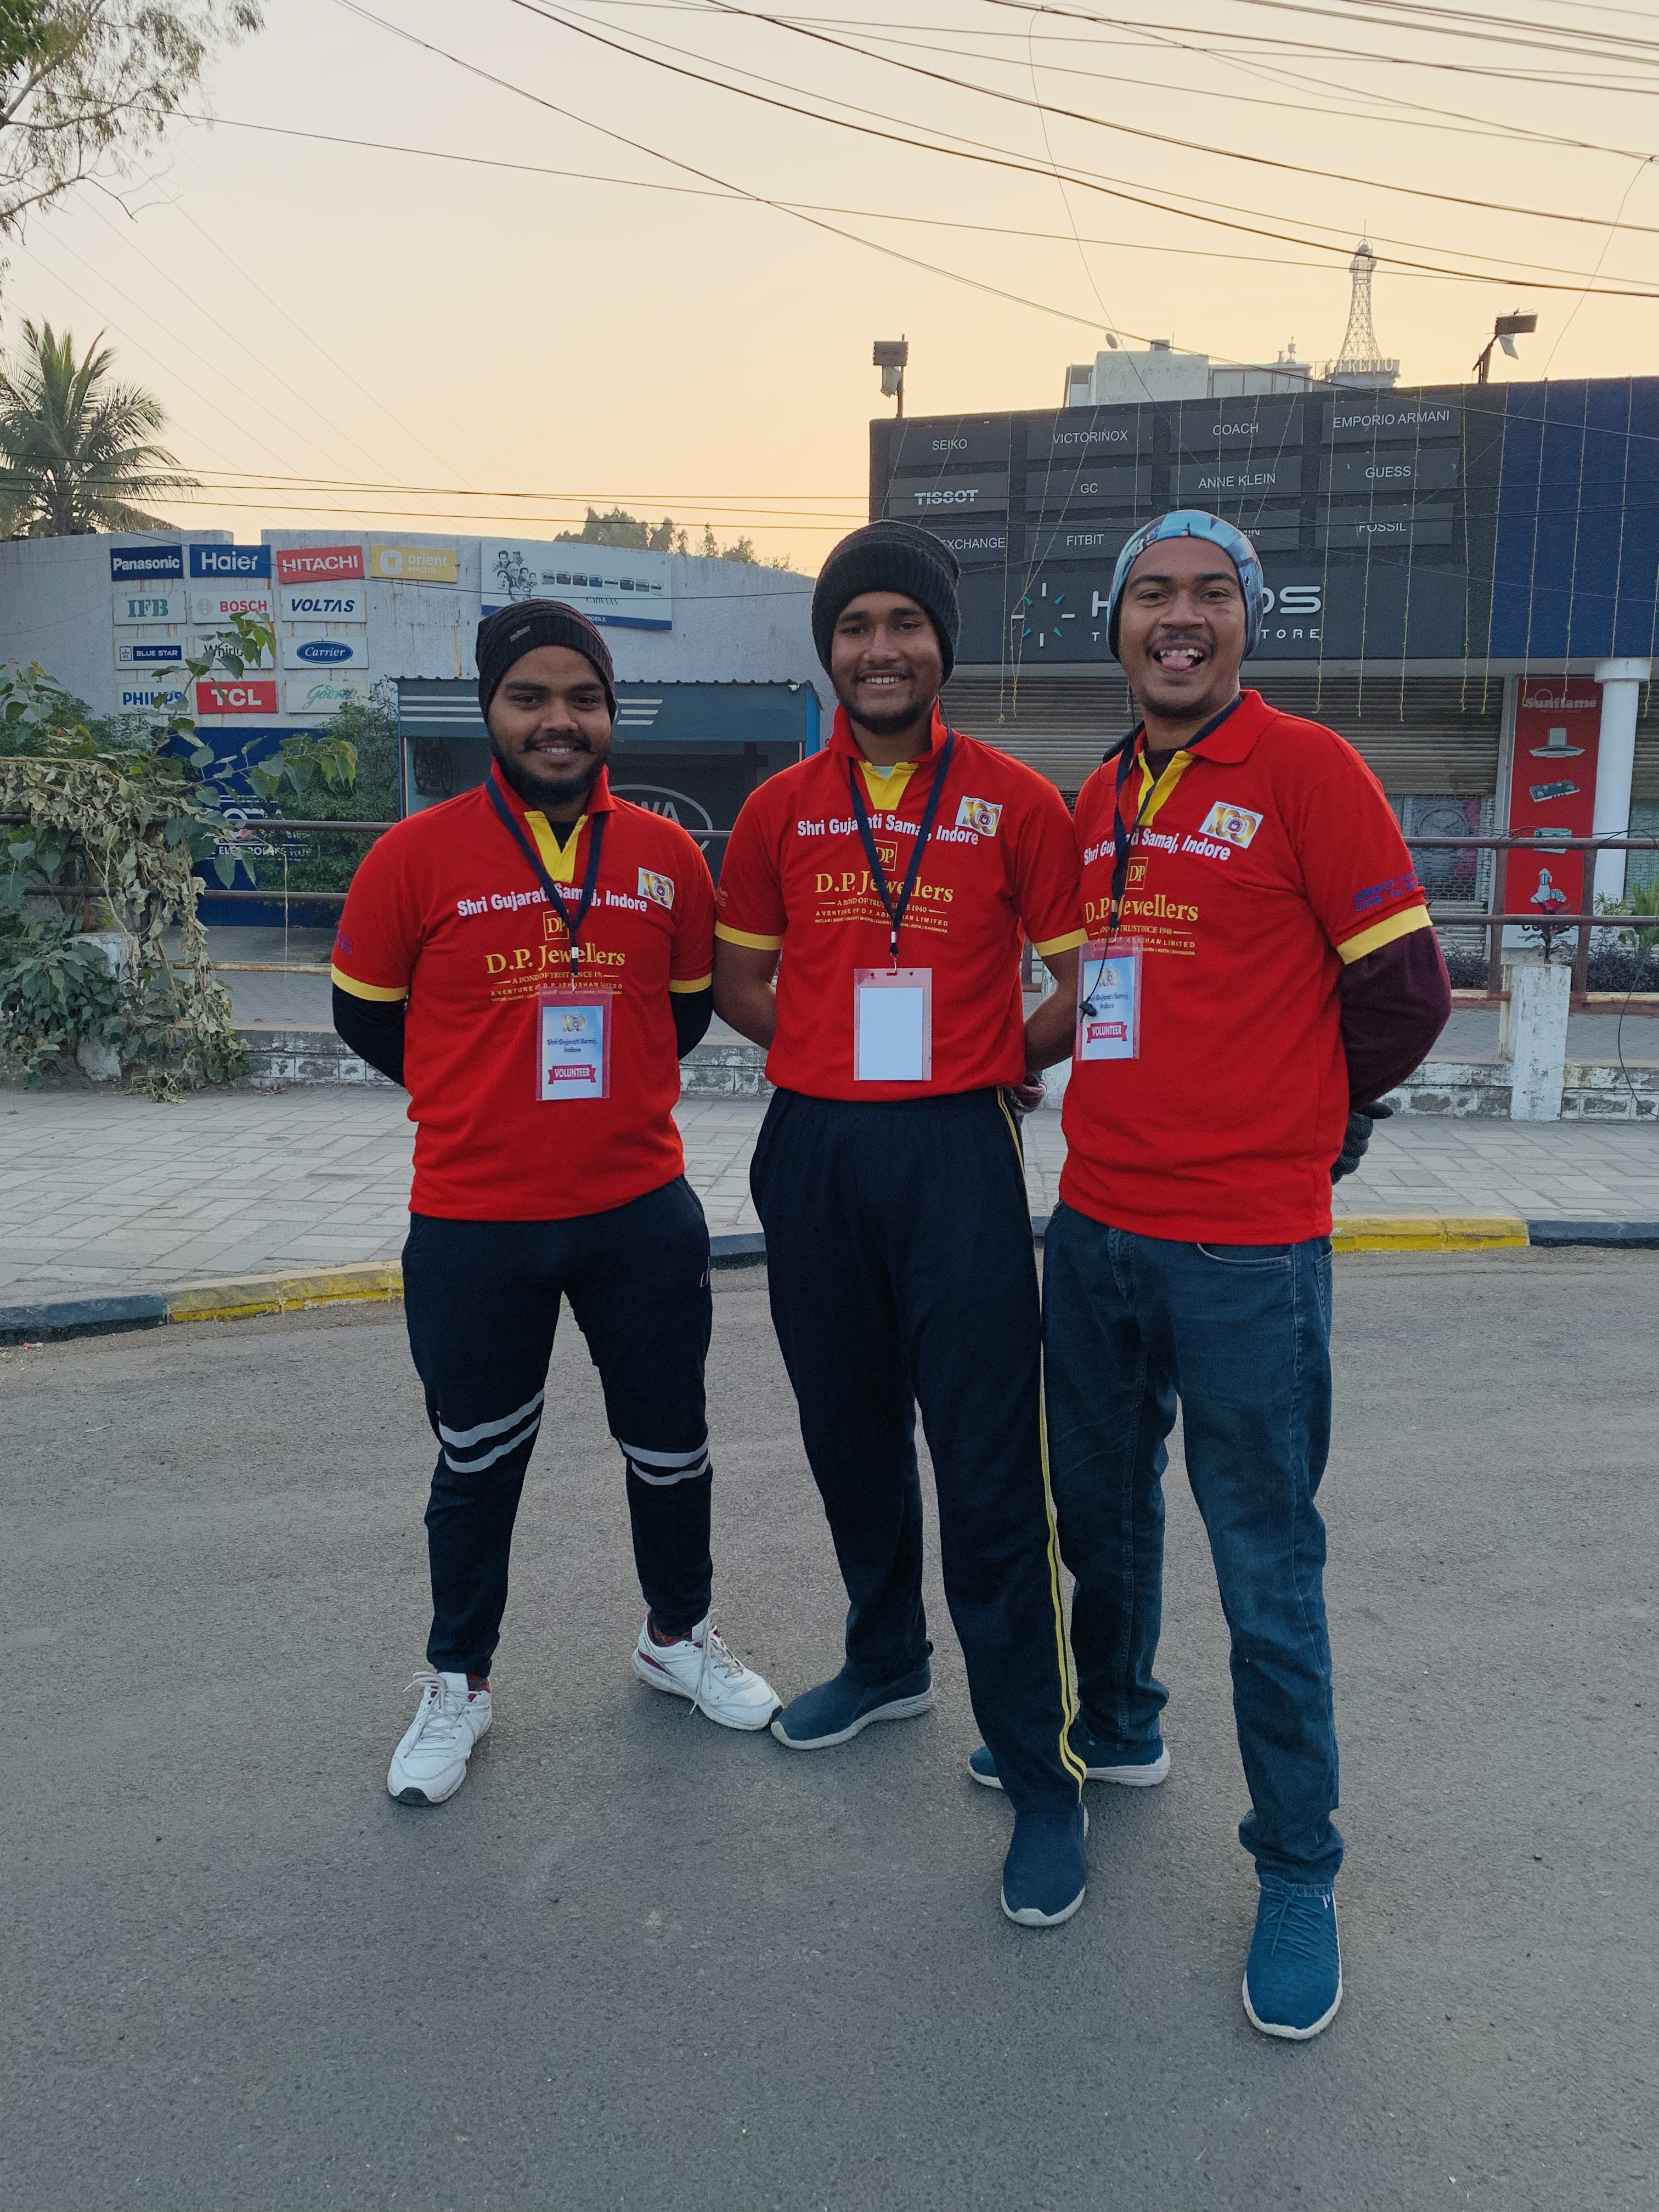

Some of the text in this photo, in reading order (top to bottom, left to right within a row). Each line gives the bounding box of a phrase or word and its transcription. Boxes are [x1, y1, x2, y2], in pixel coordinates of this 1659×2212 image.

[1333, 410, 1451, 429] EMPORIO ARMANI
[1213, 422, 1259, 436] COACH
[1053, 430, 1128, 445] VICTORINOX
[932, 439, 968, 450] SEIKO
[1365, 466, 1412, 478] GUESS
[1198, 473, 1276, 489] ANNE KLEIN
[1080, 483, 1098, 494] GC
[914, 489, 979, 505] TISSOT
[1359, 522, 1407, 533] FOSSIL
[941, 537, 1006, 550] XCHANGE
[1066, 534, 1104, 546] FITBIT
[112, 555, 180, 571] Panasonic
[201, 551, 258, 570] Haier
[283, 555, 358, 572] HITACHI
[408, 553, 447, 567] orient
[408, 566, 437, 574] electric
[127, 598, 168, 618] IFB
[219, 600, 268, 612] BOSCH
[291, 599, 356, 612] VOLTAS
[1261, 629, 1320, 639] TORE
[136, 648, 178, 657] BLUE STAR
[304, 647, 346, 657] Carrier
[211, 688, 262, 706] TCL
[1525, 697, 1596, 708] Sunflame
[797, 813, 979, 845] Shri Gujaati Sama, Indore
[1084, 843, 1099, 866] Shri
[1141, 827, 1180, 854] Samaj,
[1181, 834, 1232, 861] Indore
[1128, 865, 1146, 882] DP
[457, 883, 647, 917] Shri Gujarat Samj, Indore
[870, 898, 885, 908] TRUS
[912, 905, 927, 913] 1940
[1085, 897, 1110, 924] D.P
[916, 916, 949, 927] LIMITED
[1164, 939, 1195, 947] LIMITED
[485, 942, 625, 974] D.P. Jewellers
[519, 974, 539, 984] BOND
[497, 986, 533, 995] VENTURE
[1092, 1025, 1122, 1036] VOLUNTEER
[554, 1067, 590, 1078] VOLUNTEER
